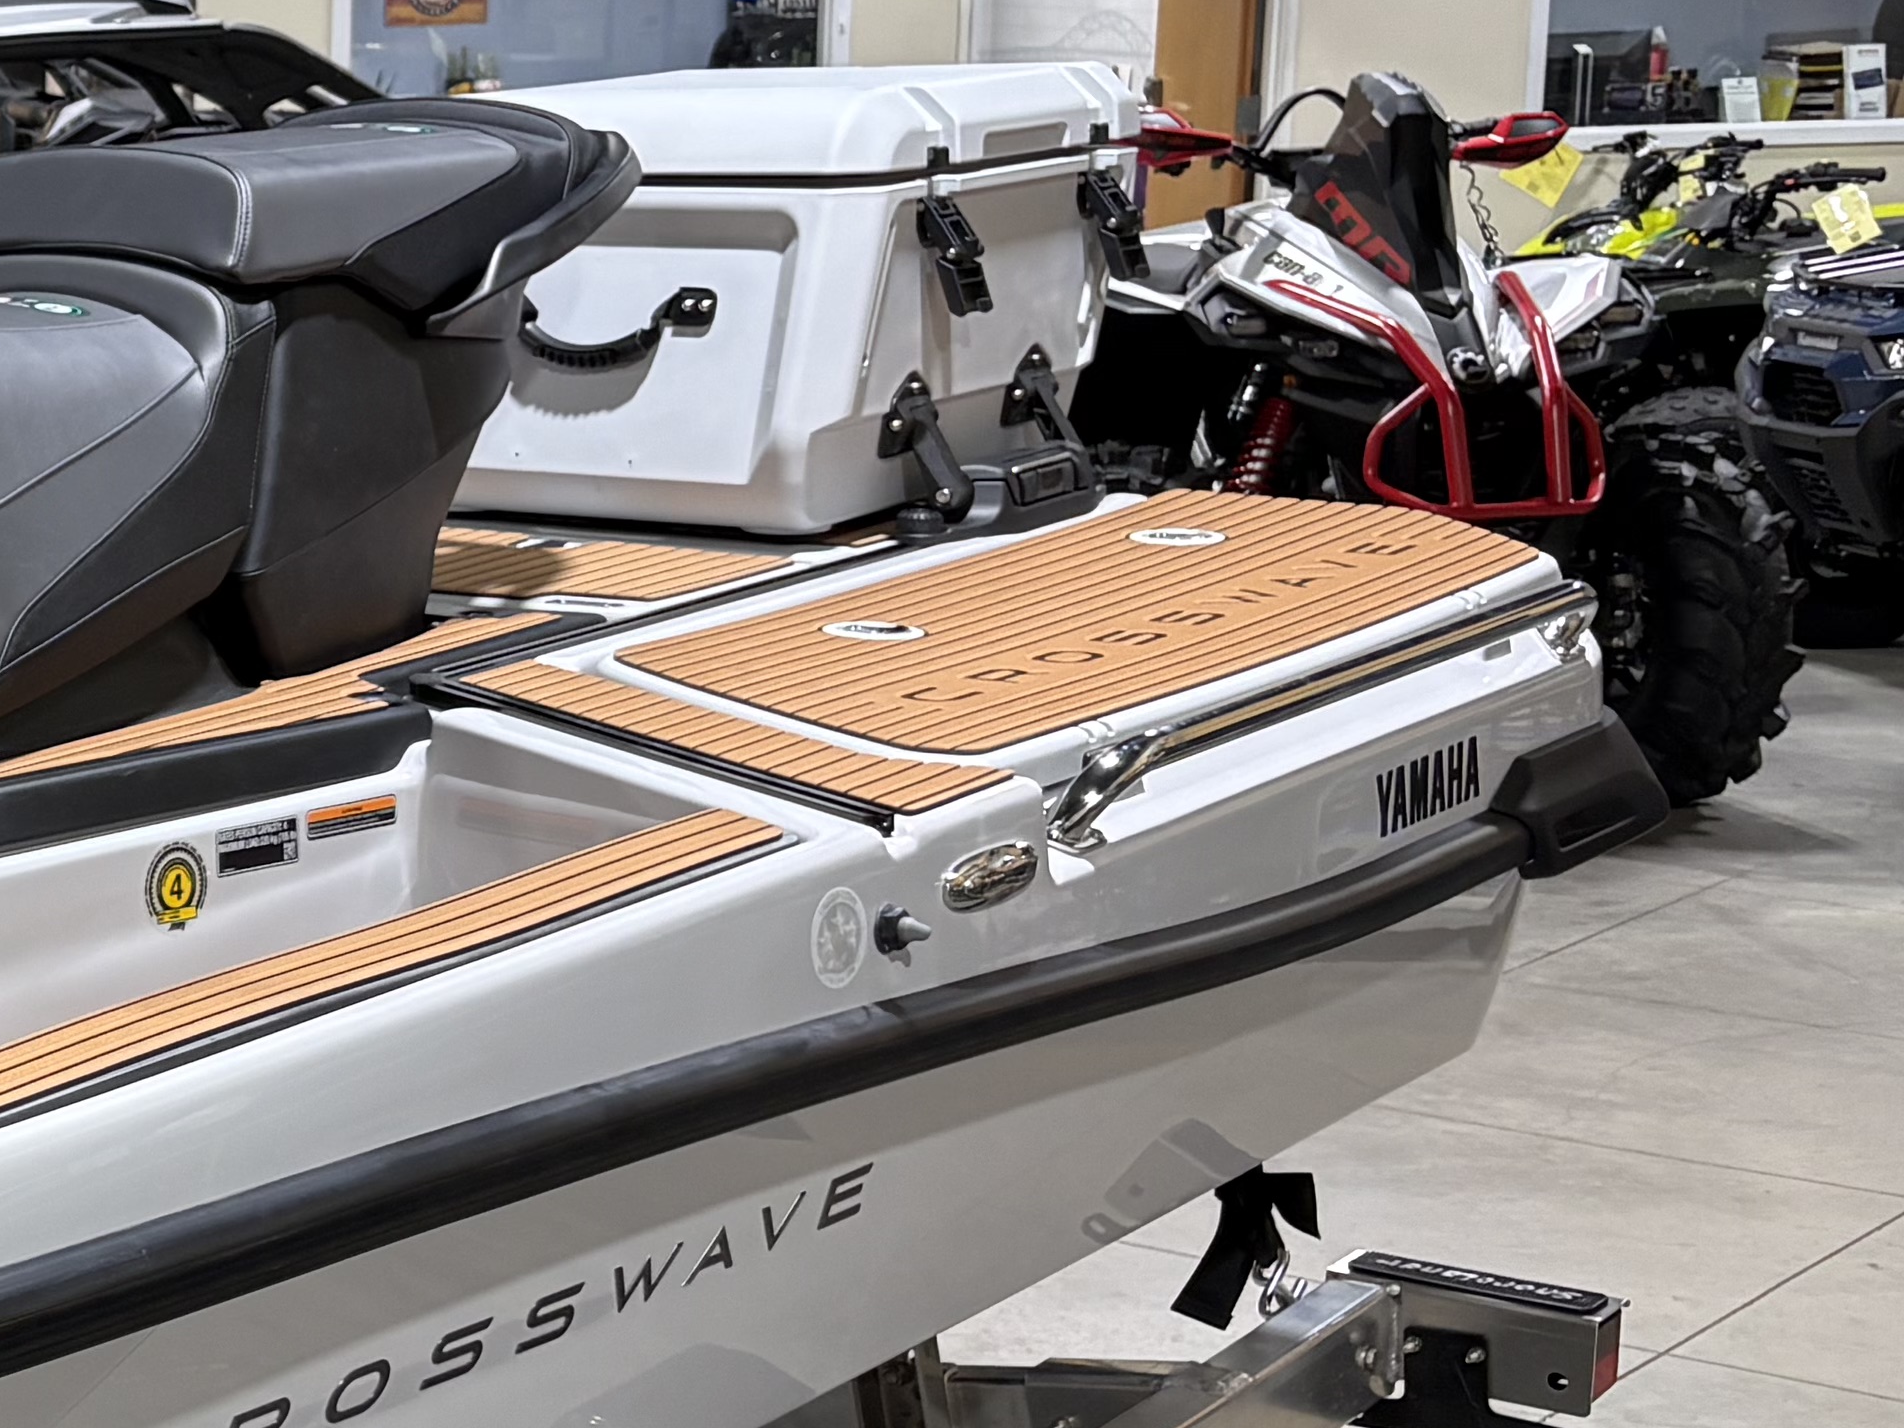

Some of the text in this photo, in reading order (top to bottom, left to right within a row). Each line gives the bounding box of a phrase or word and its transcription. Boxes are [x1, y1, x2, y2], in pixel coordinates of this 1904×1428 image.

[1262, 250, 1345, 297] can-a
[1376, 735, 1481, 838] YAMAHA
[169, 873, 184, 901] 4
